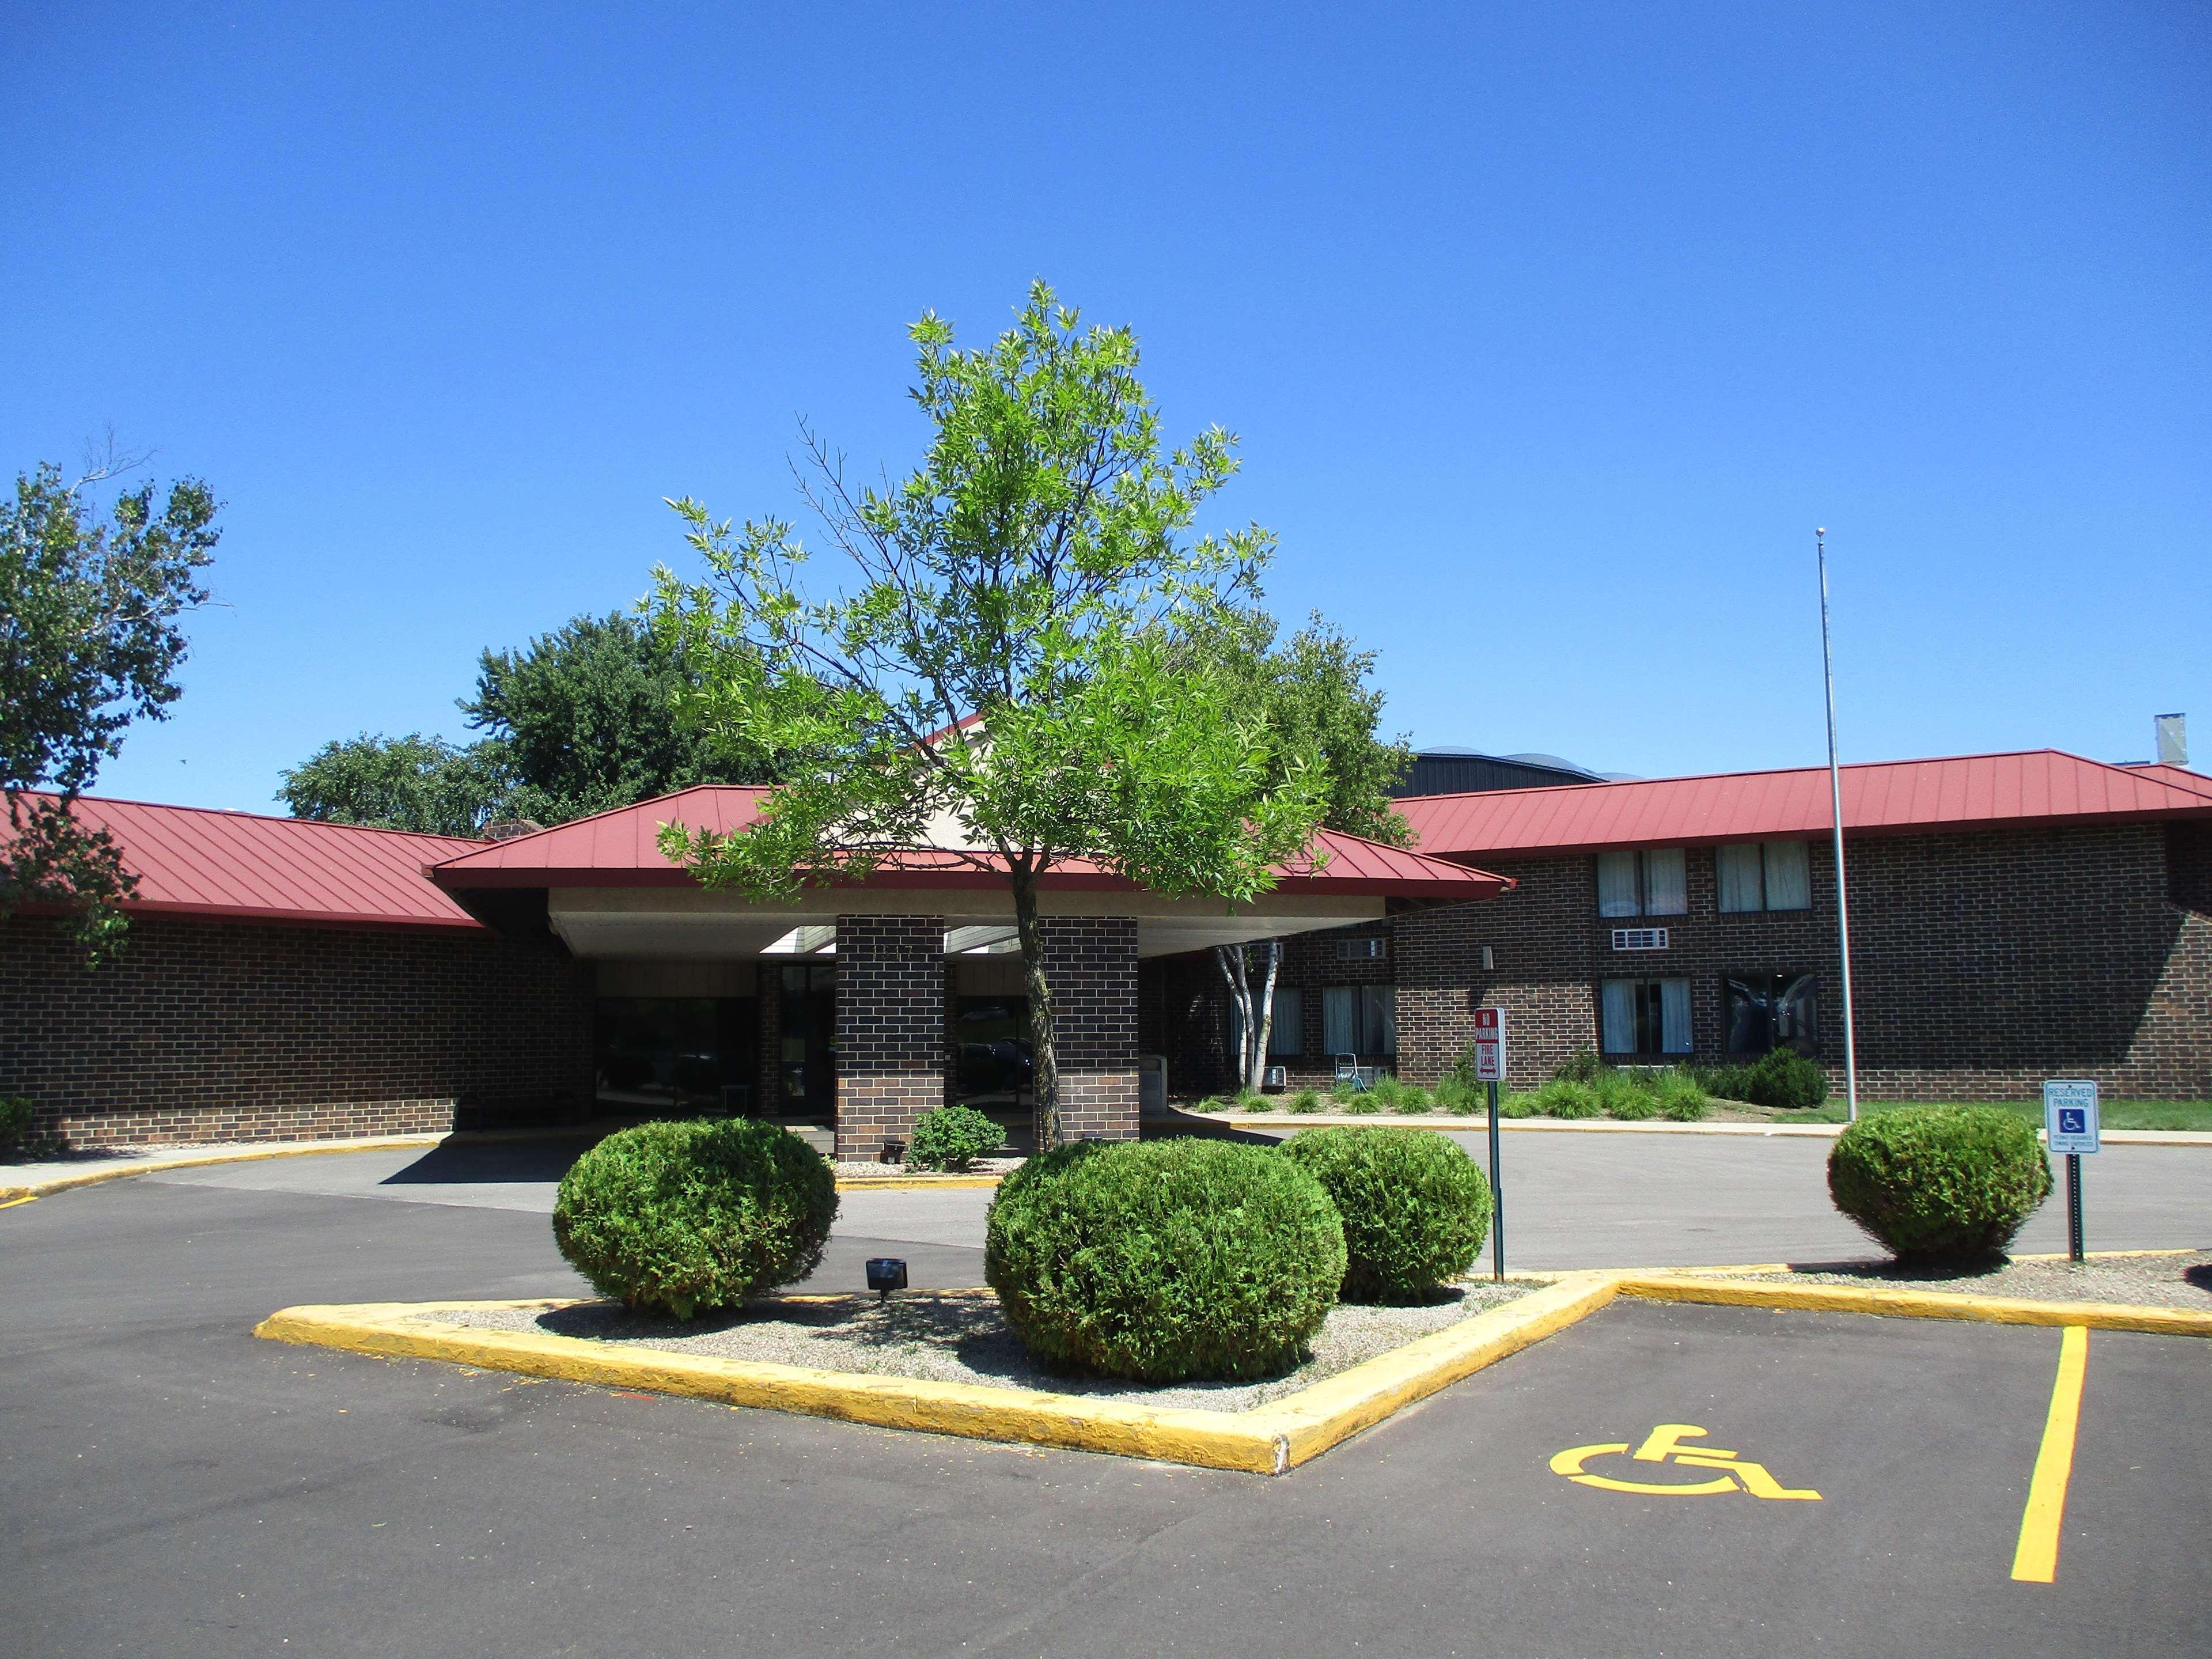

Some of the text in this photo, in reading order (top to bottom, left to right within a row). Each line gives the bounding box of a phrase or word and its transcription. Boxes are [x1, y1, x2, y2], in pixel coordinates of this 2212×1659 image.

[1482, 1013, 1490, 1026] NO
[1475, 1027, 1498, 1040] PARKING
[1482, 1044, 1493, 1055] FIRE
[1481, 1055, 1494, 1066] LANE
[2048, 1088, 2093, 1097] RESERVED
[2054, 1098, 2089, 1107] PARKING
